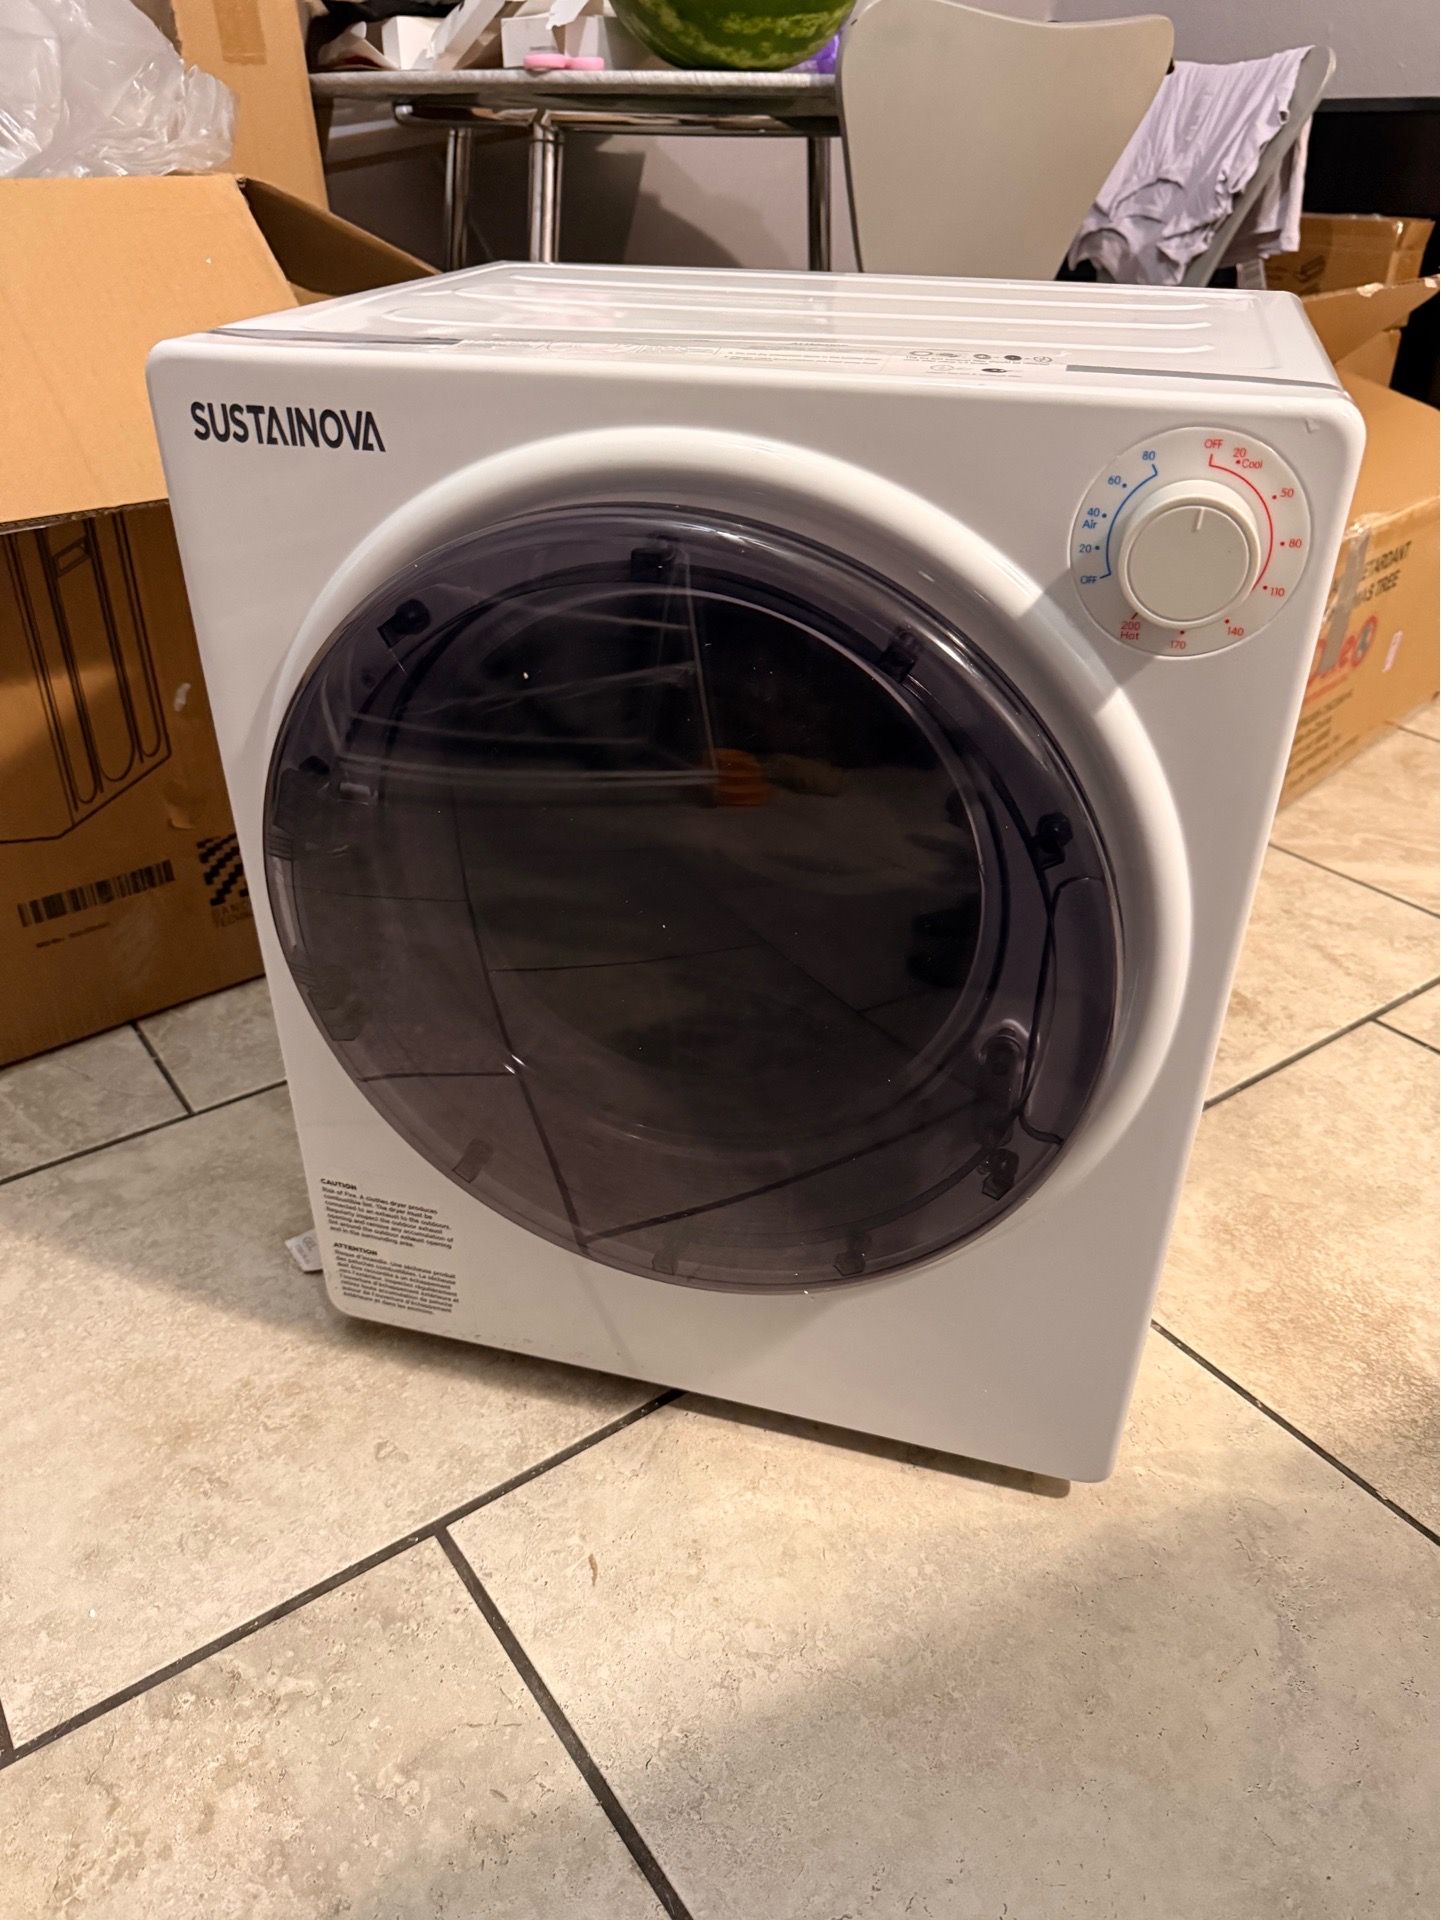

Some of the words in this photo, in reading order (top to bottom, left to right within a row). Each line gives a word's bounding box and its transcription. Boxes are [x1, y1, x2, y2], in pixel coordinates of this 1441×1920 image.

[191, 402, 386, 452] SUSTAINOVA
[1204, 440, 1223, 449] OFF
[1142, 451, 1156, 461] 80
[1233, 448, 1247, 458] 20
[1242, 459, 1263, 469] Cool
[1108, 476, 1121, 486] 60
[1280, 489, 1295, 498] 50
[1087, 509, 1100, 518] 40
[1082, 521, 1097, 529] Air
[1079, 545, 1092, 553] 20
[1289, 540, 1302, 549] 80
[1081, 576, 1098, 585] OFF
[1271, 588, 1285, 597] 110
[1120, 622, 1141, 631] 200
[1120, 631, 1140, 641] Hot
[1227, 627, 1244, 637] 140
[1171, 641, 1186, 650] 170
[320, 1178, 356, 1190] CAUTION
[333, 1242, 377, 1256] ATTENTION
